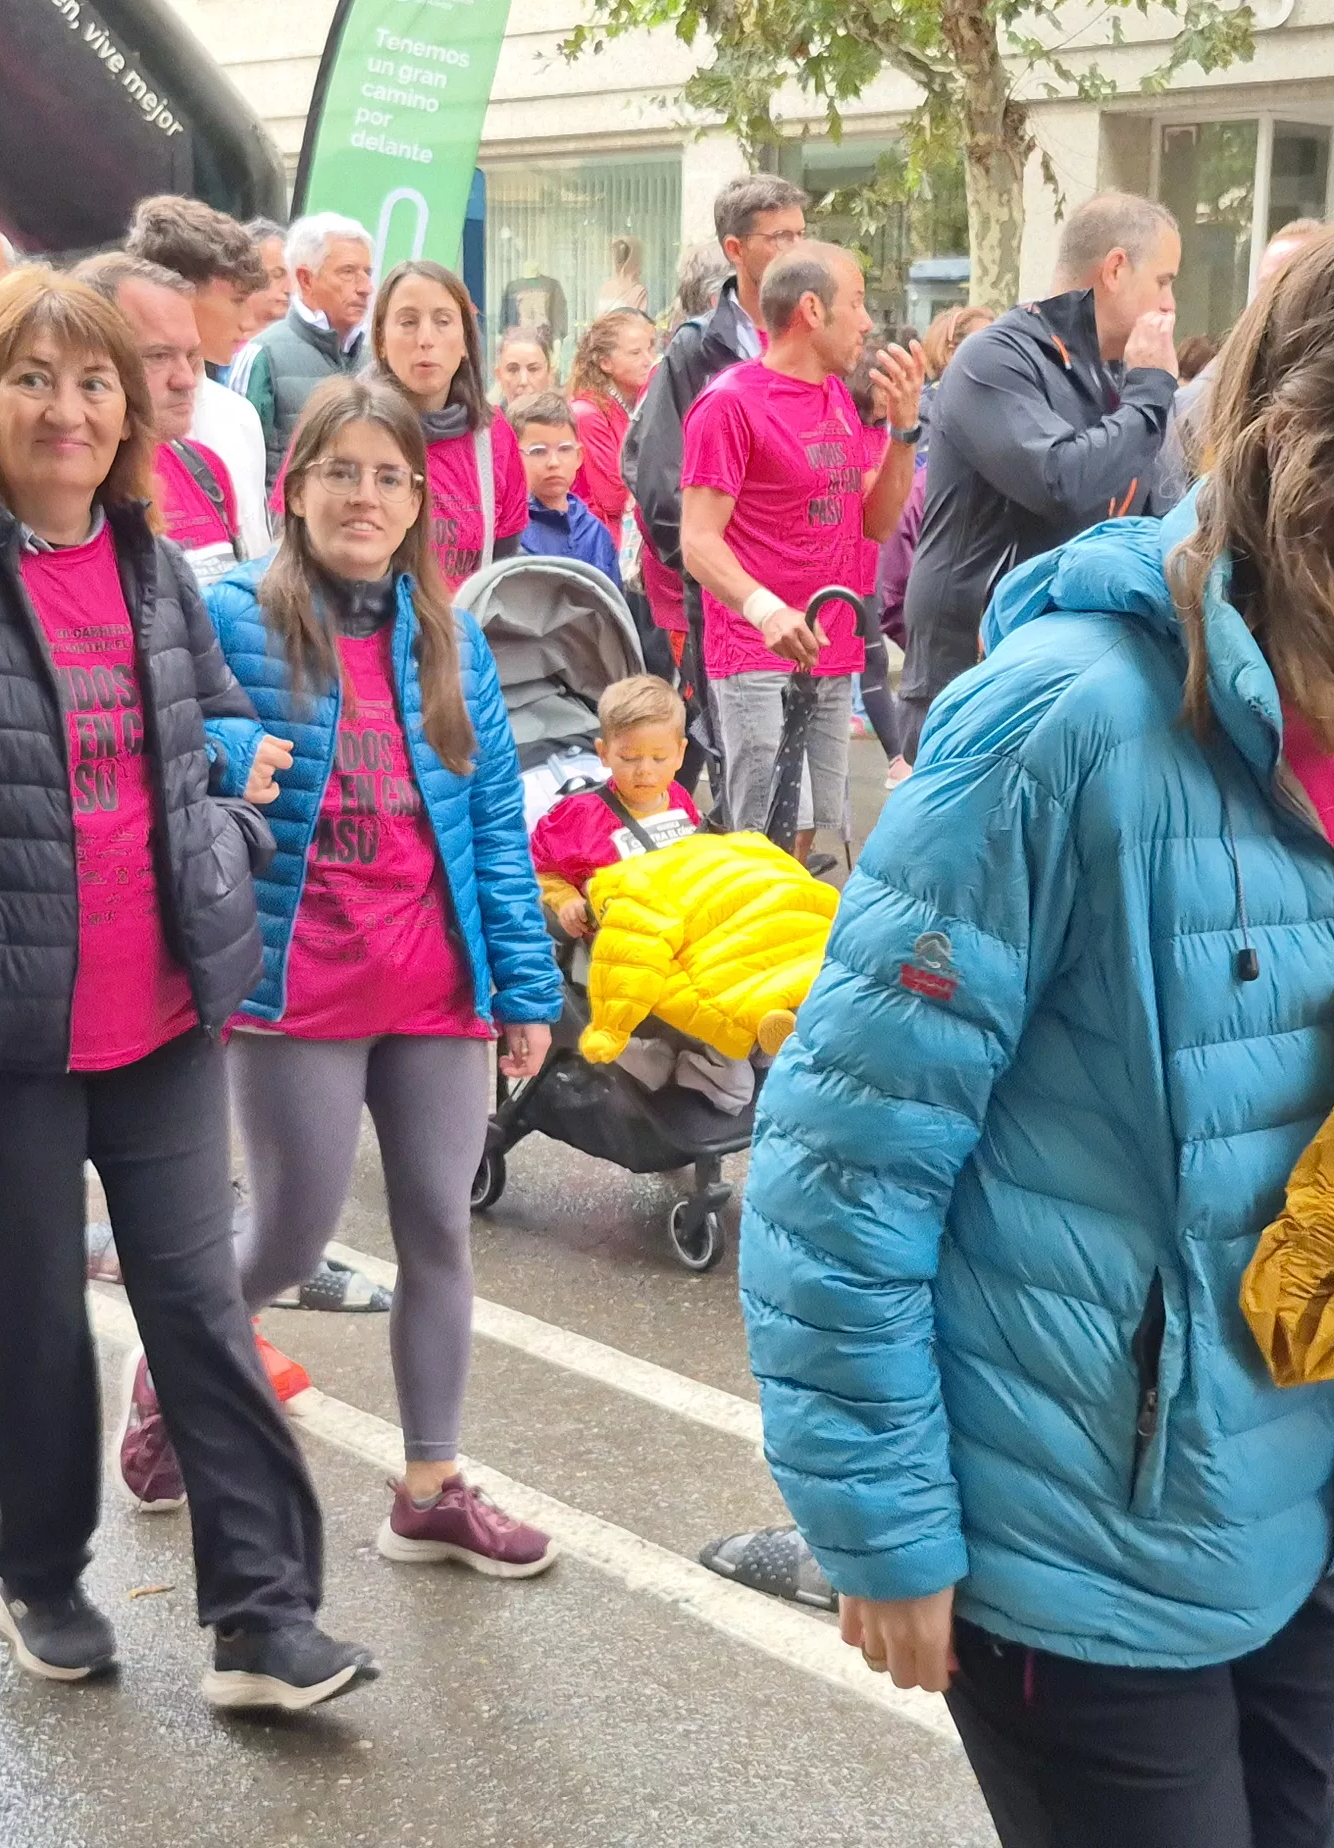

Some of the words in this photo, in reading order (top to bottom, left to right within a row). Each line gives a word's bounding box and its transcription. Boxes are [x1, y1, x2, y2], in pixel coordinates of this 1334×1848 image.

[376, 27, 471, 68] Tenemos
[83, 22, 125, 73] vive
[121, 70, 184, 136] mejor
[367, 57, 395, 76] un
[398, 64, 447, 89] gran
[361, 82, 439, 113] camino
[355, 107, 393, 127] por
[351, 130, 433, 163] delante
[75, 714, 116, 760] EN
[340, 774, 376, 816] EN
